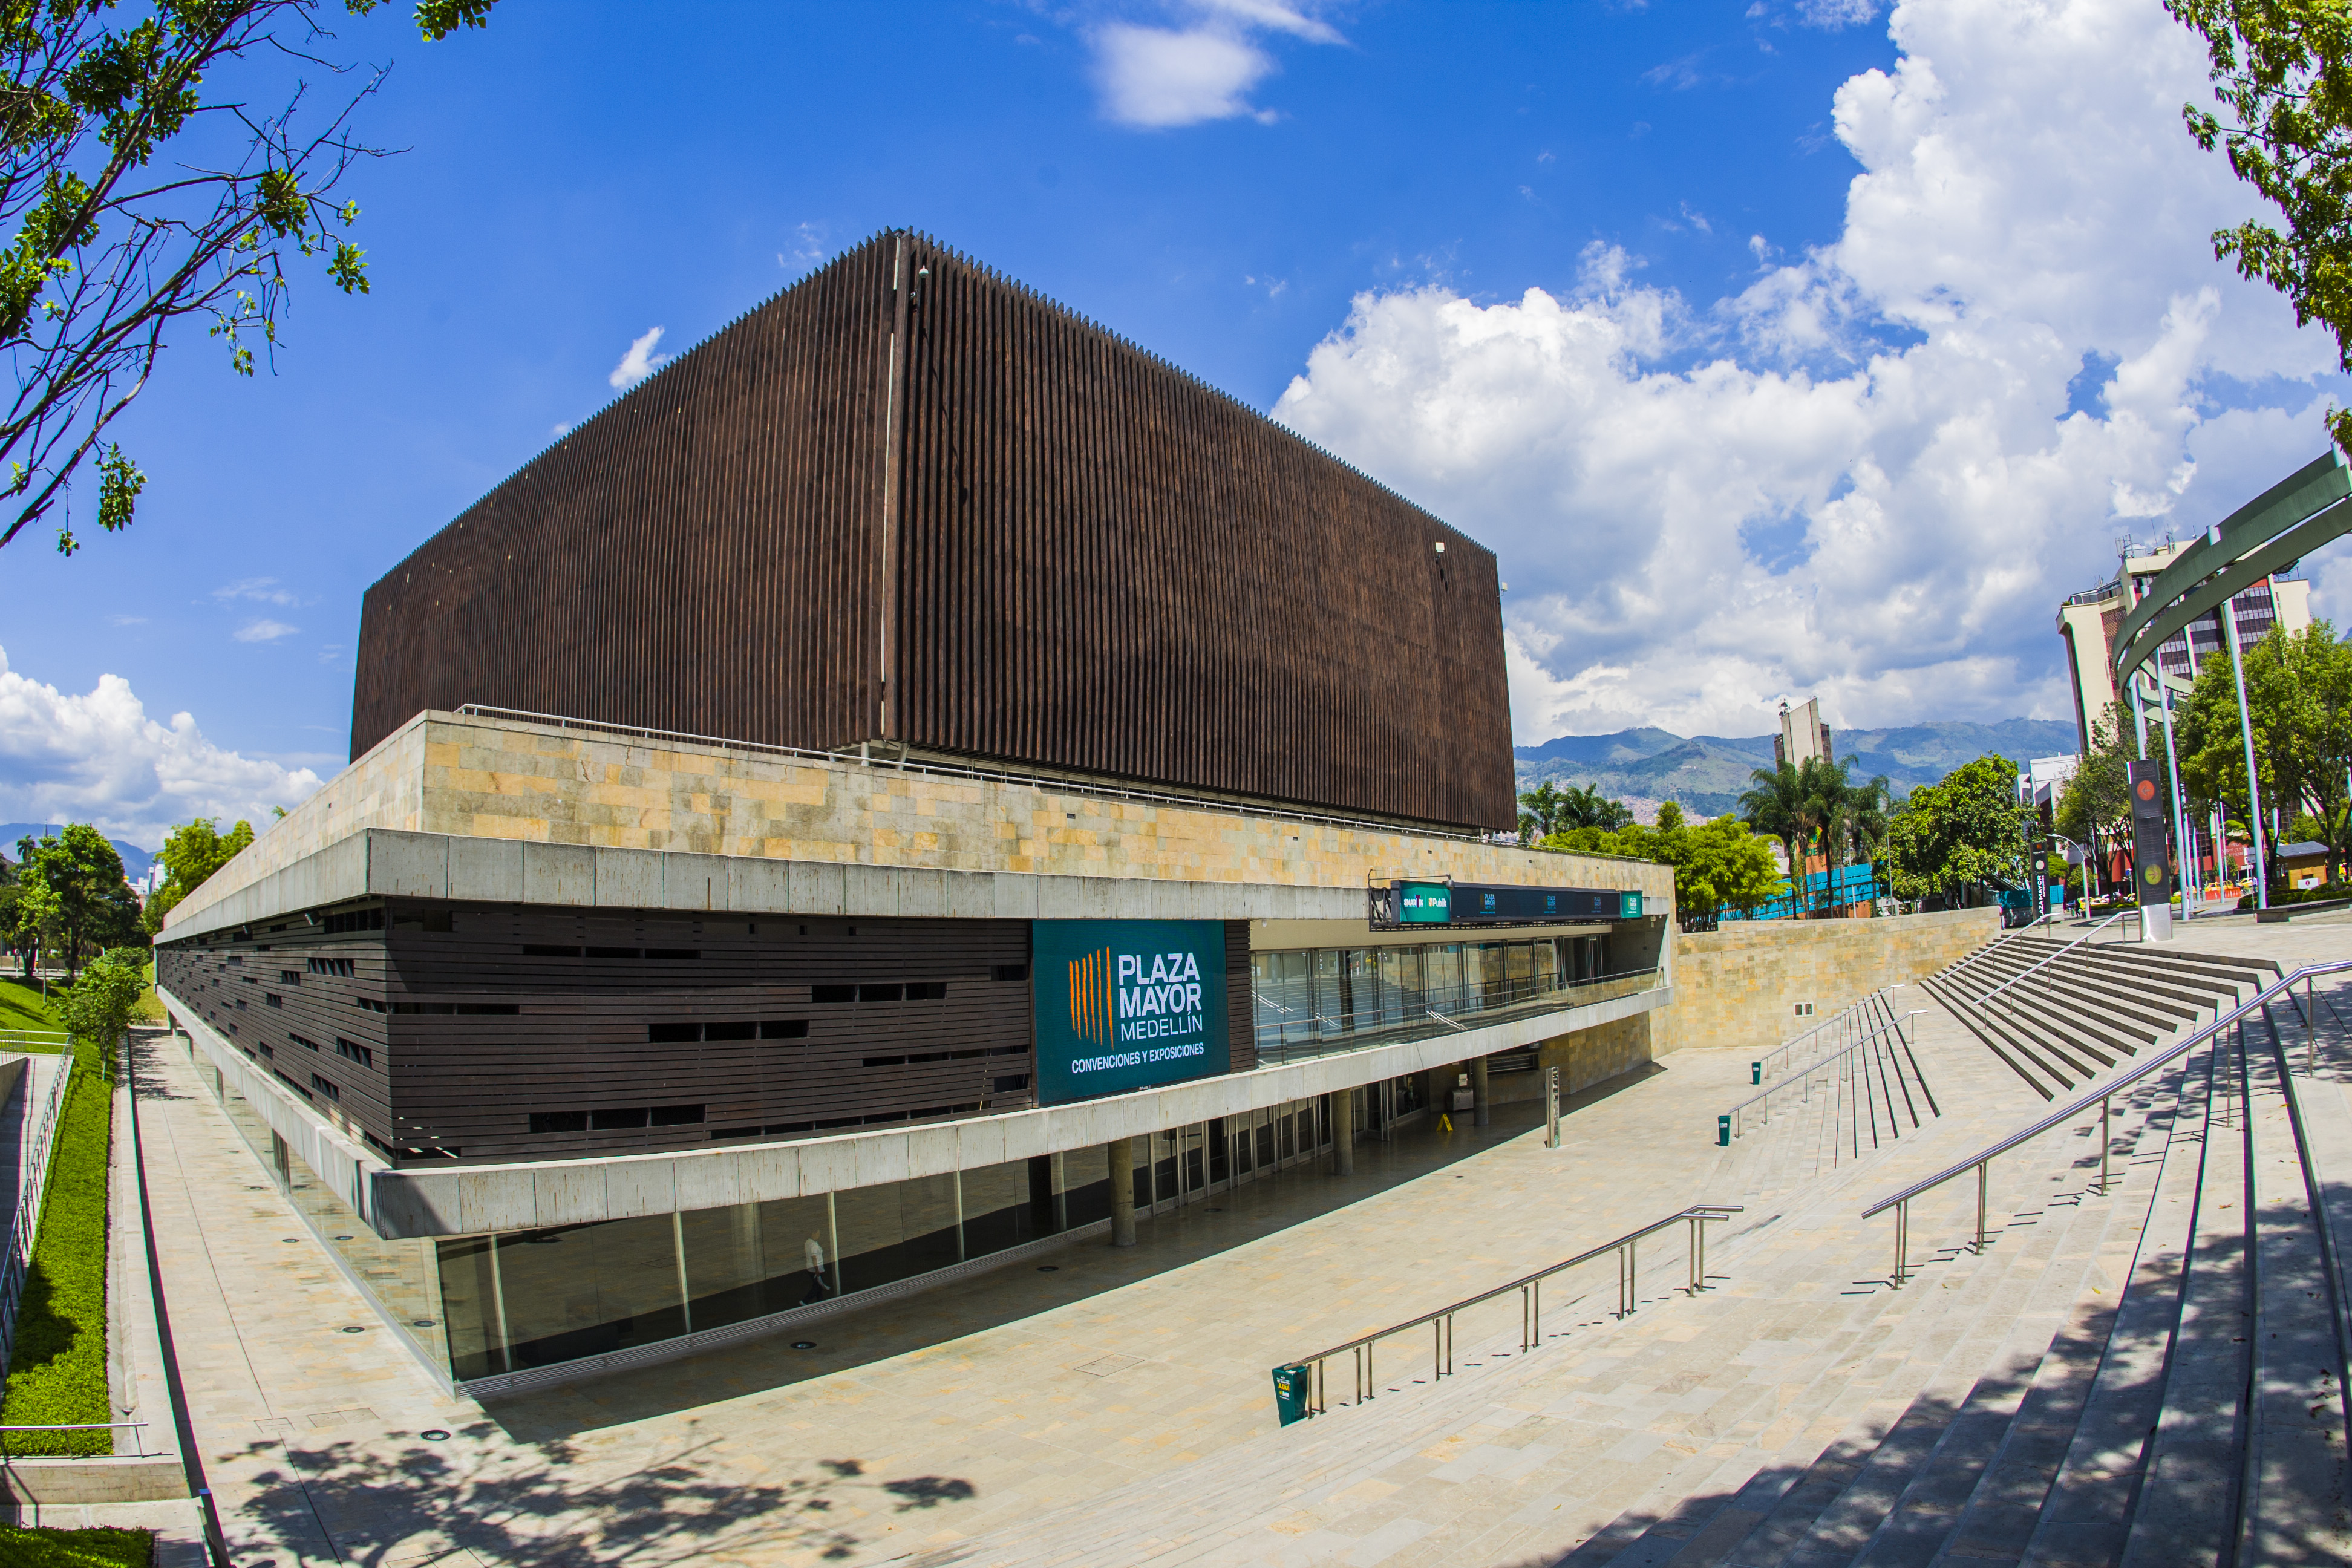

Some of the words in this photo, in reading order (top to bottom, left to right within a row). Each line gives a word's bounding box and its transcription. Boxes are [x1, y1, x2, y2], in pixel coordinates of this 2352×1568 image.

[1432, 898, 1447, 907] Publik
[1118, 952, 1200, 985] PLAZA
[1119, 982, 1201, 1019] MAYOR
[1120, 1011, 1203, 1042] MEDELLÍN
[1071, 1052, 1140, 1074] CONVENCIONES
[1142, 1051, 1148, 1063] Y
[1149, 1042, 1204, 1062] EXPOSICIONES
